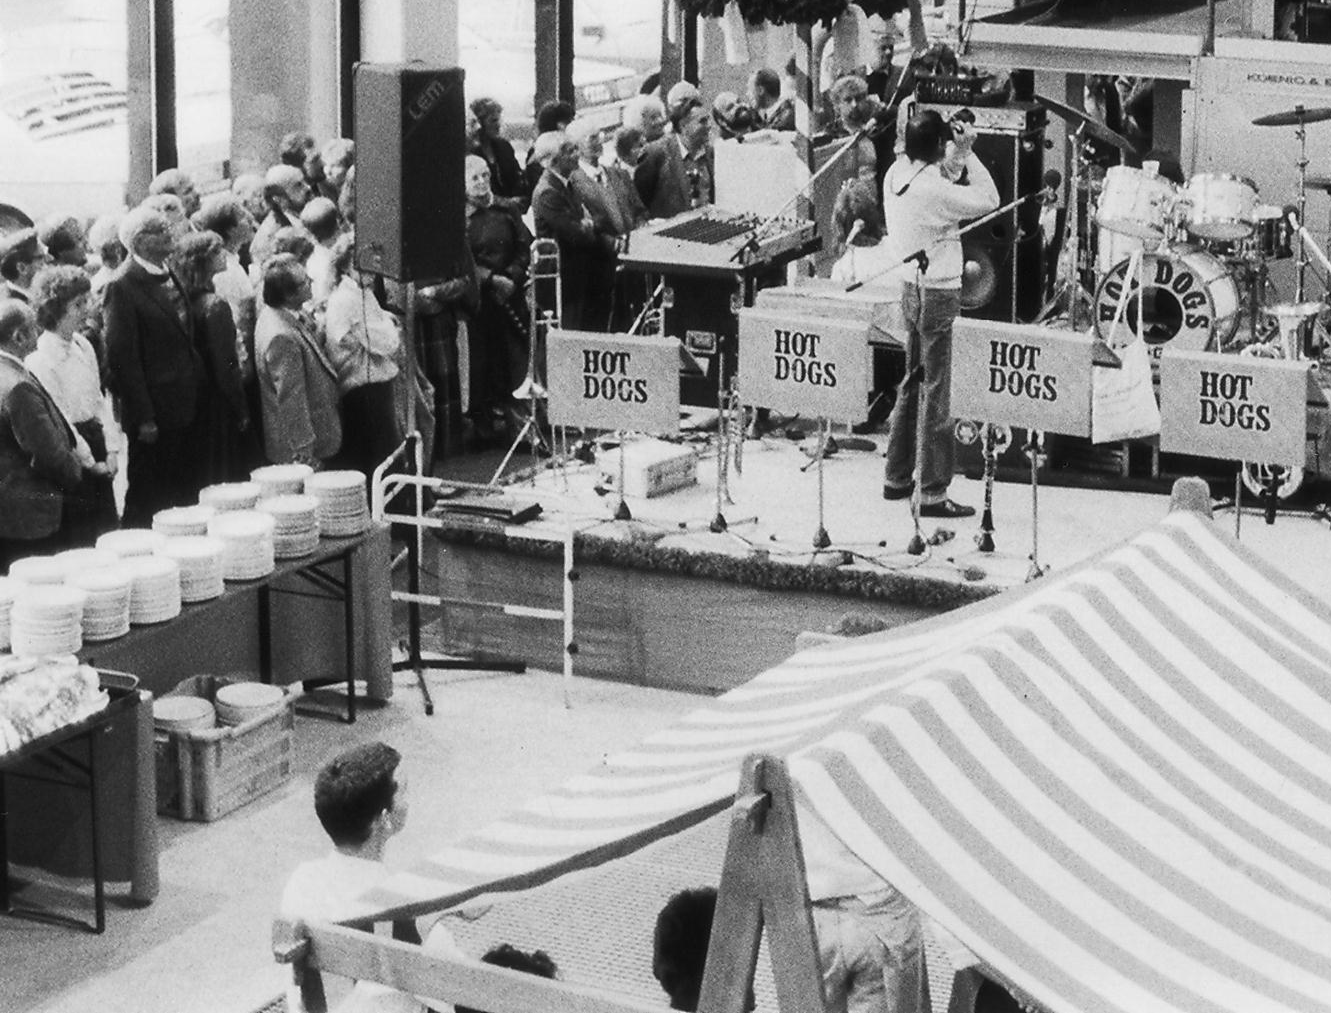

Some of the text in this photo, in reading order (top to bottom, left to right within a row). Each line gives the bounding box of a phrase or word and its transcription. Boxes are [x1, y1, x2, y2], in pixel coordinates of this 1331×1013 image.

[1154, 259, 1210, 329] DOGS
[774, 329, 821, 358] HOT
[989, 339, 1041, 370] HOT
[583, 349, 630, 376] HOT
[774, 355, 837, 388] DOGS
[583, 375, 648, 404] DOGS
[988, 367, 1058, 402] DOGS
[1199, 370, 1253, 400] HOT
[1199, 398, 1271, 432] DOGS
